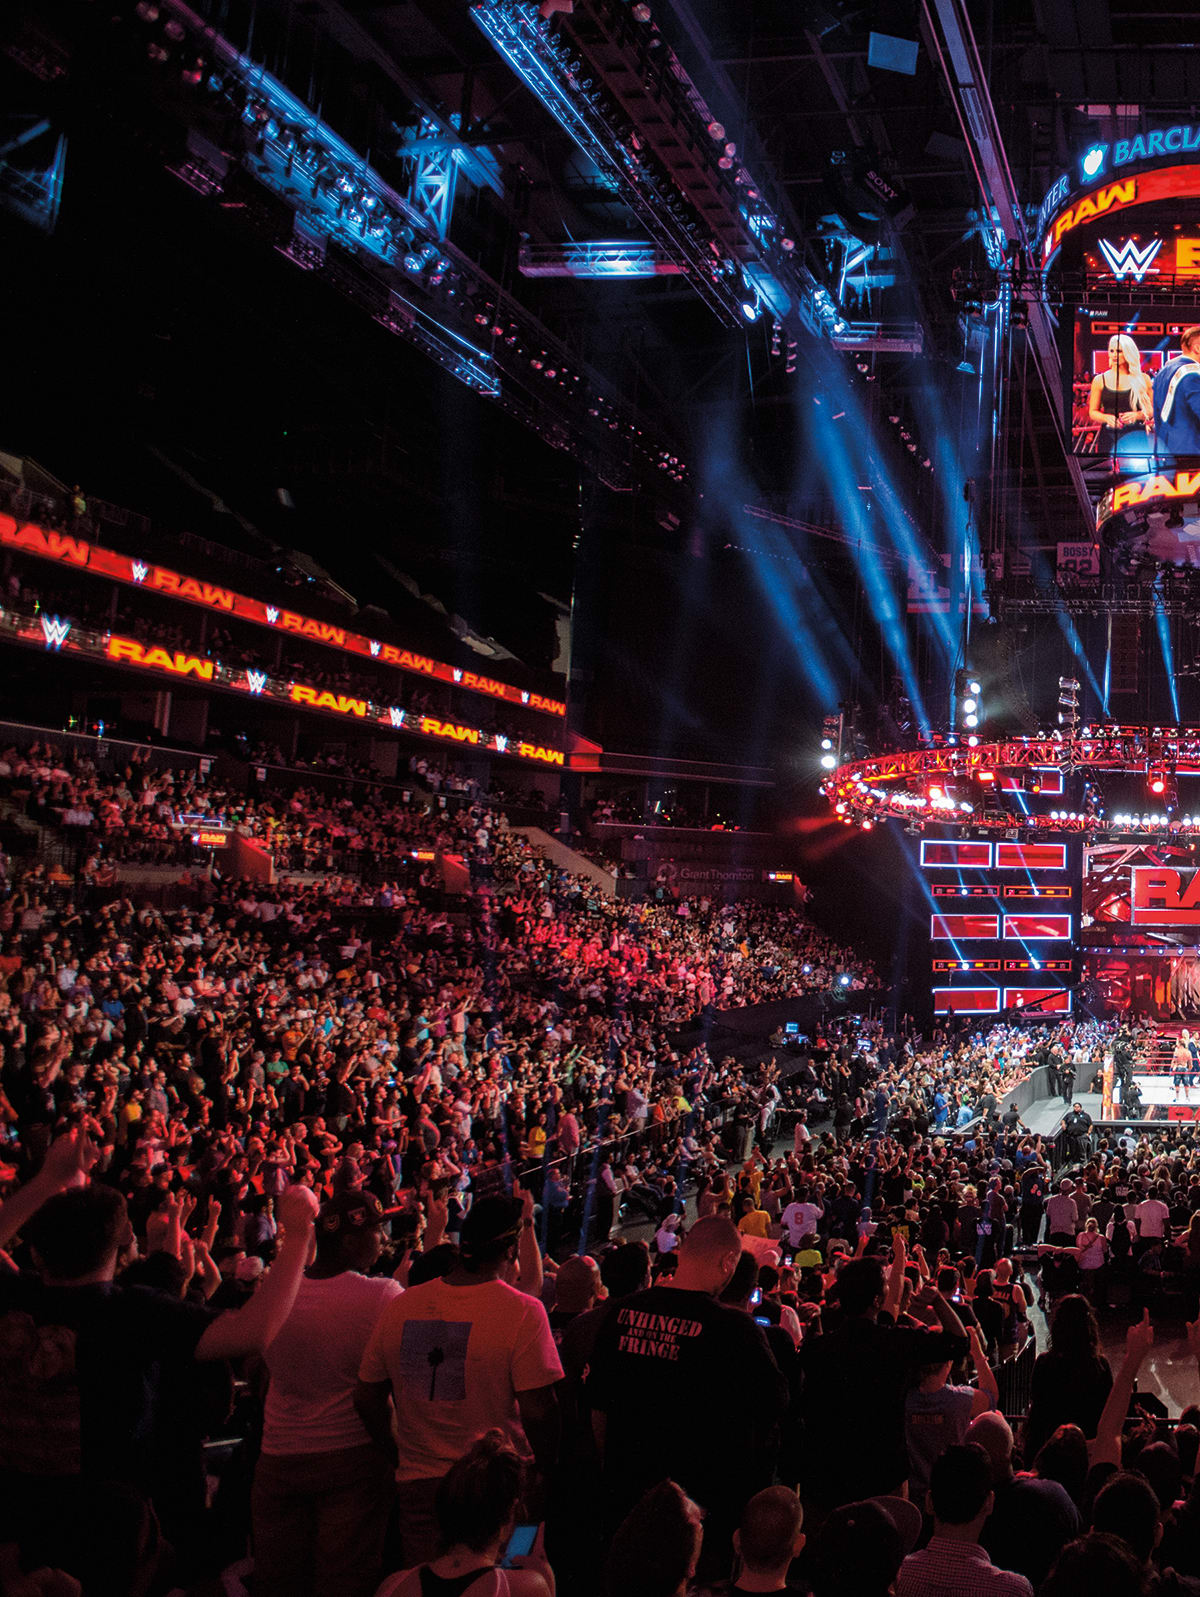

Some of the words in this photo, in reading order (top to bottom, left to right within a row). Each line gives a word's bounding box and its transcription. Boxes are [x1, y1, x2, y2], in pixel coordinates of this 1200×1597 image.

[866, 170, 898, 198] SONY
[1055, 180, 1136, 242] RAW
[1063, 547, 1093, 557] BOSSY
[153, 569, 234, 609] RAW
[282, 612, 345, 644] RAW
[383, 645, 434, 673] RAW
[464, 672, 505, 695] RAW
[530, 694, 565, 715] RAW
[109, 637, 214, 680] RAW
[292, 685, 366, 717] RAW
[423, 718, 478, 744] RAW
[520, 742, 564, 764] RAW
[680, 868, 709, 880] Grant
[710, 868, 754, 880] Thornton
[617, 1308, 703, 1337] UNHINGED
[627, 1328, 644, 1338] AND
[658, 1332, 676, 1343] THE
[618, 1336, 680, 1361] FRINGE
